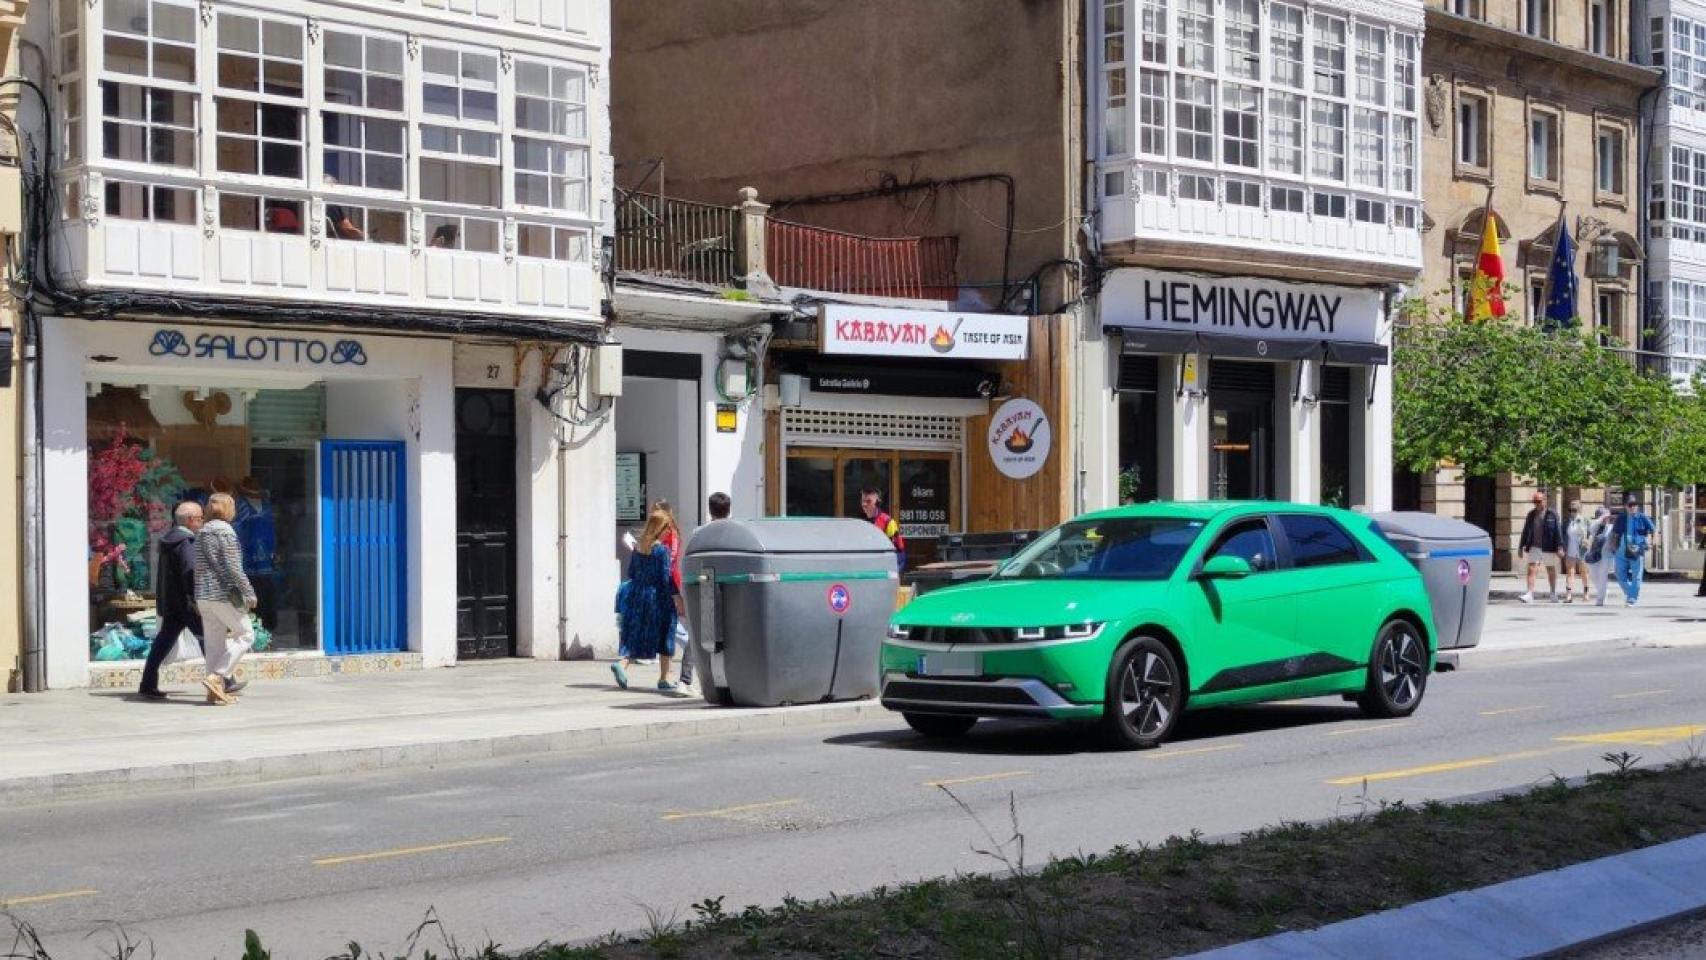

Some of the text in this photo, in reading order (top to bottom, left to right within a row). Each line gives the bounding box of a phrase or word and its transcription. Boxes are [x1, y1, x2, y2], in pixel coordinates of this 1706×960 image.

[1144, 280, 1342, 333] HEMINGWAY
[836, 319, 1023, 345] KABAYAN TASTE OF ASIA
[194, 333, 327, 363] SALOTTO
[487, 364, 500, 379] 27
